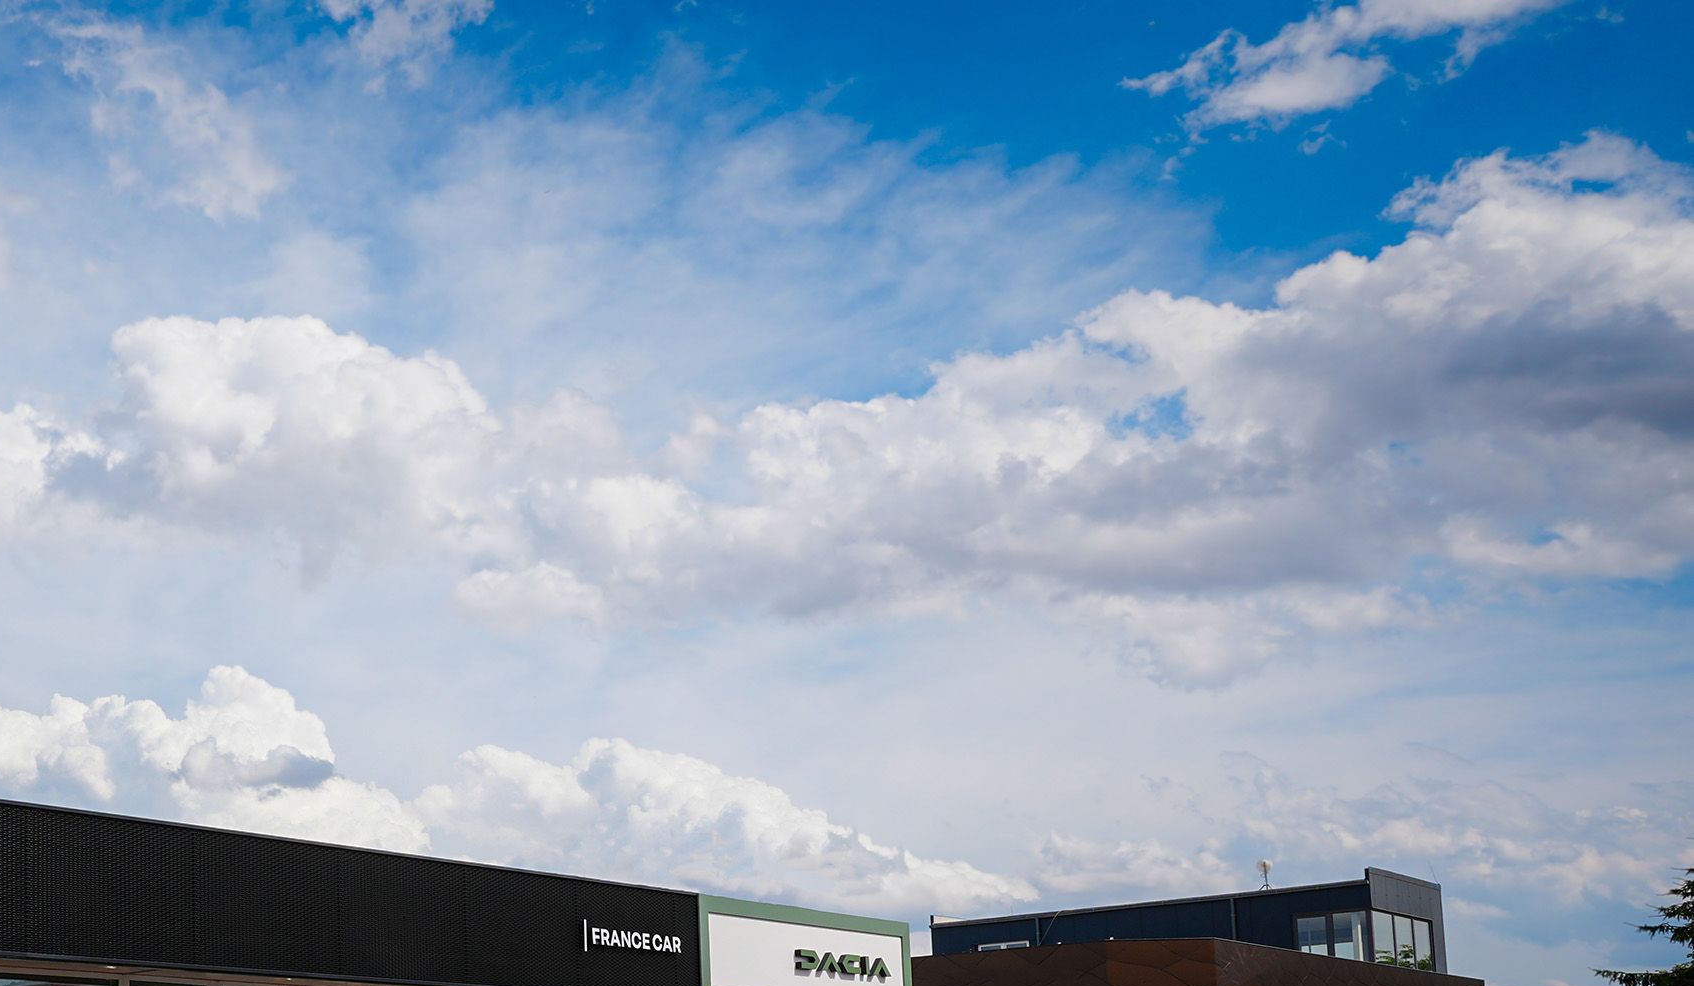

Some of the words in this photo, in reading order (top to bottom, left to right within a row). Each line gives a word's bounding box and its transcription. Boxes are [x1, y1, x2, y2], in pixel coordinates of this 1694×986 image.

[591, 927, 651, 950] FRANCE
[652, 934, 682, 954] CAR
[794, 948, 892, 978] DACIA
